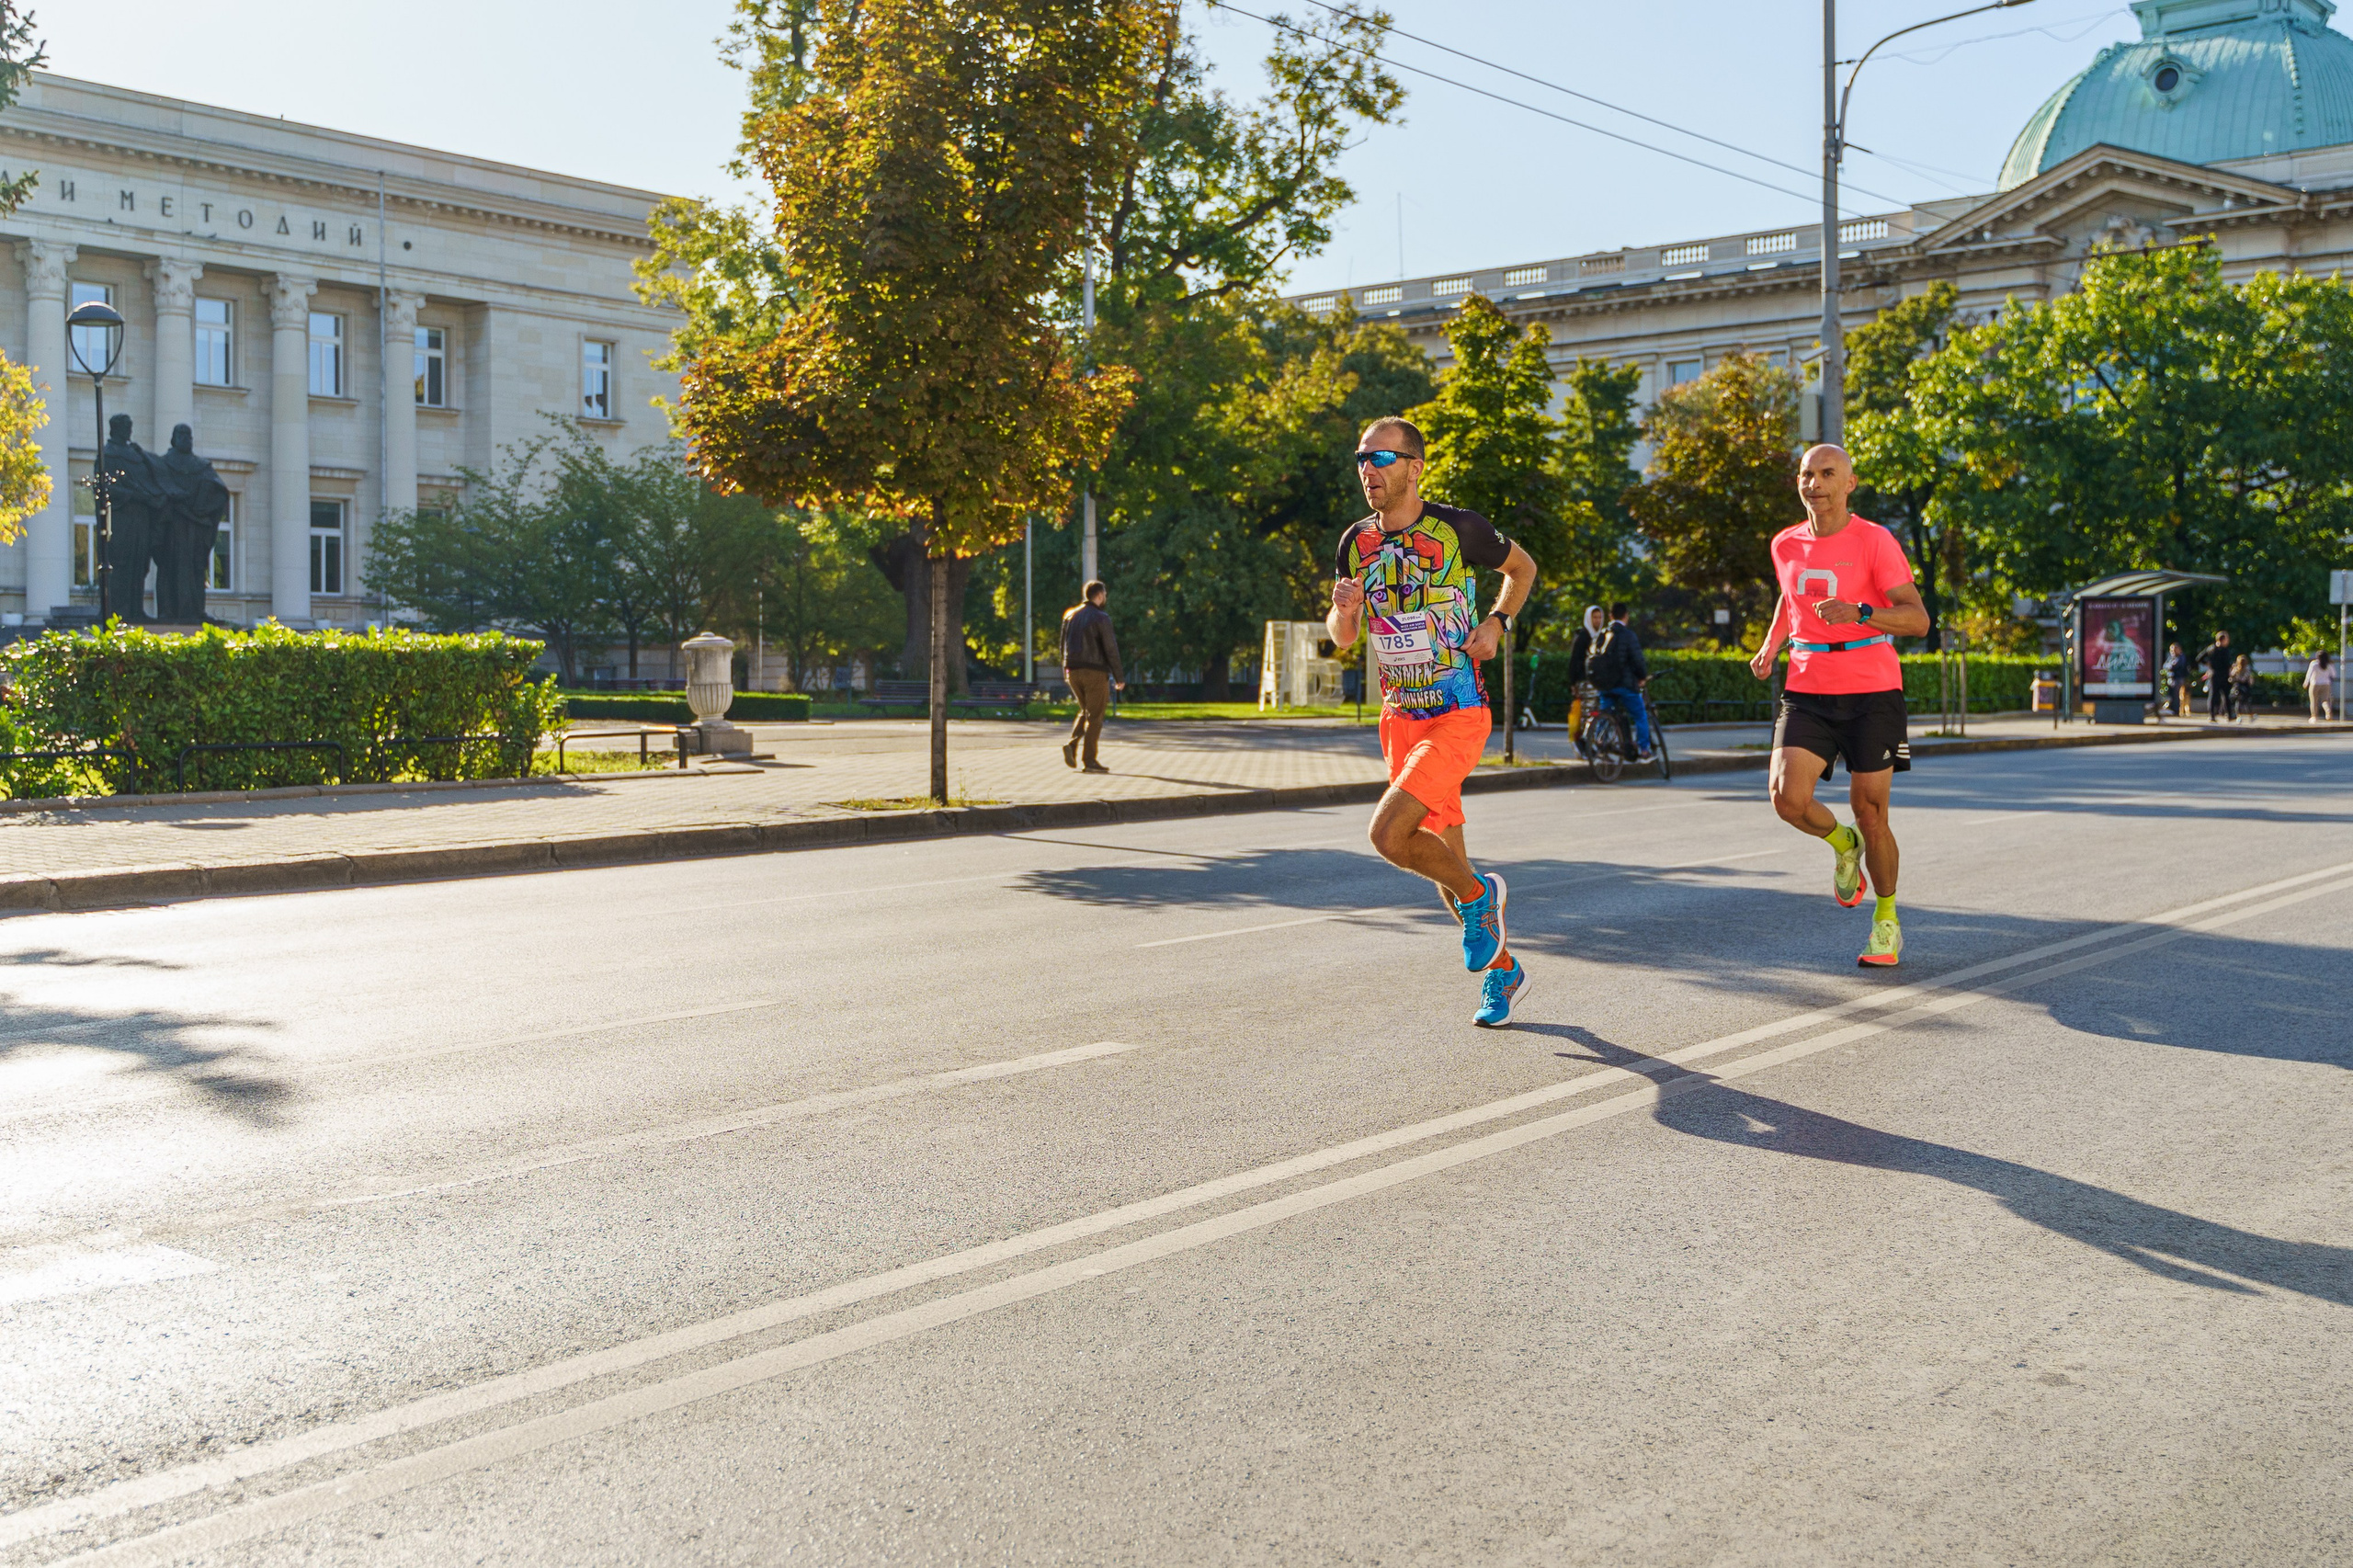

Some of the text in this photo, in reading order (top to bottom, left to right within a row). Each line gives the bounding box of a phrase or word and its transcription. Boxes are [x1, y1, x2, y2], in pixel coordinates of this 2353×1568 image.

[60, 179, 362, 247] И МЕТОДИЙ
[1379, 634, 1415, 650] 1785
[1400, 688, 1444, 709] RUNNERS
